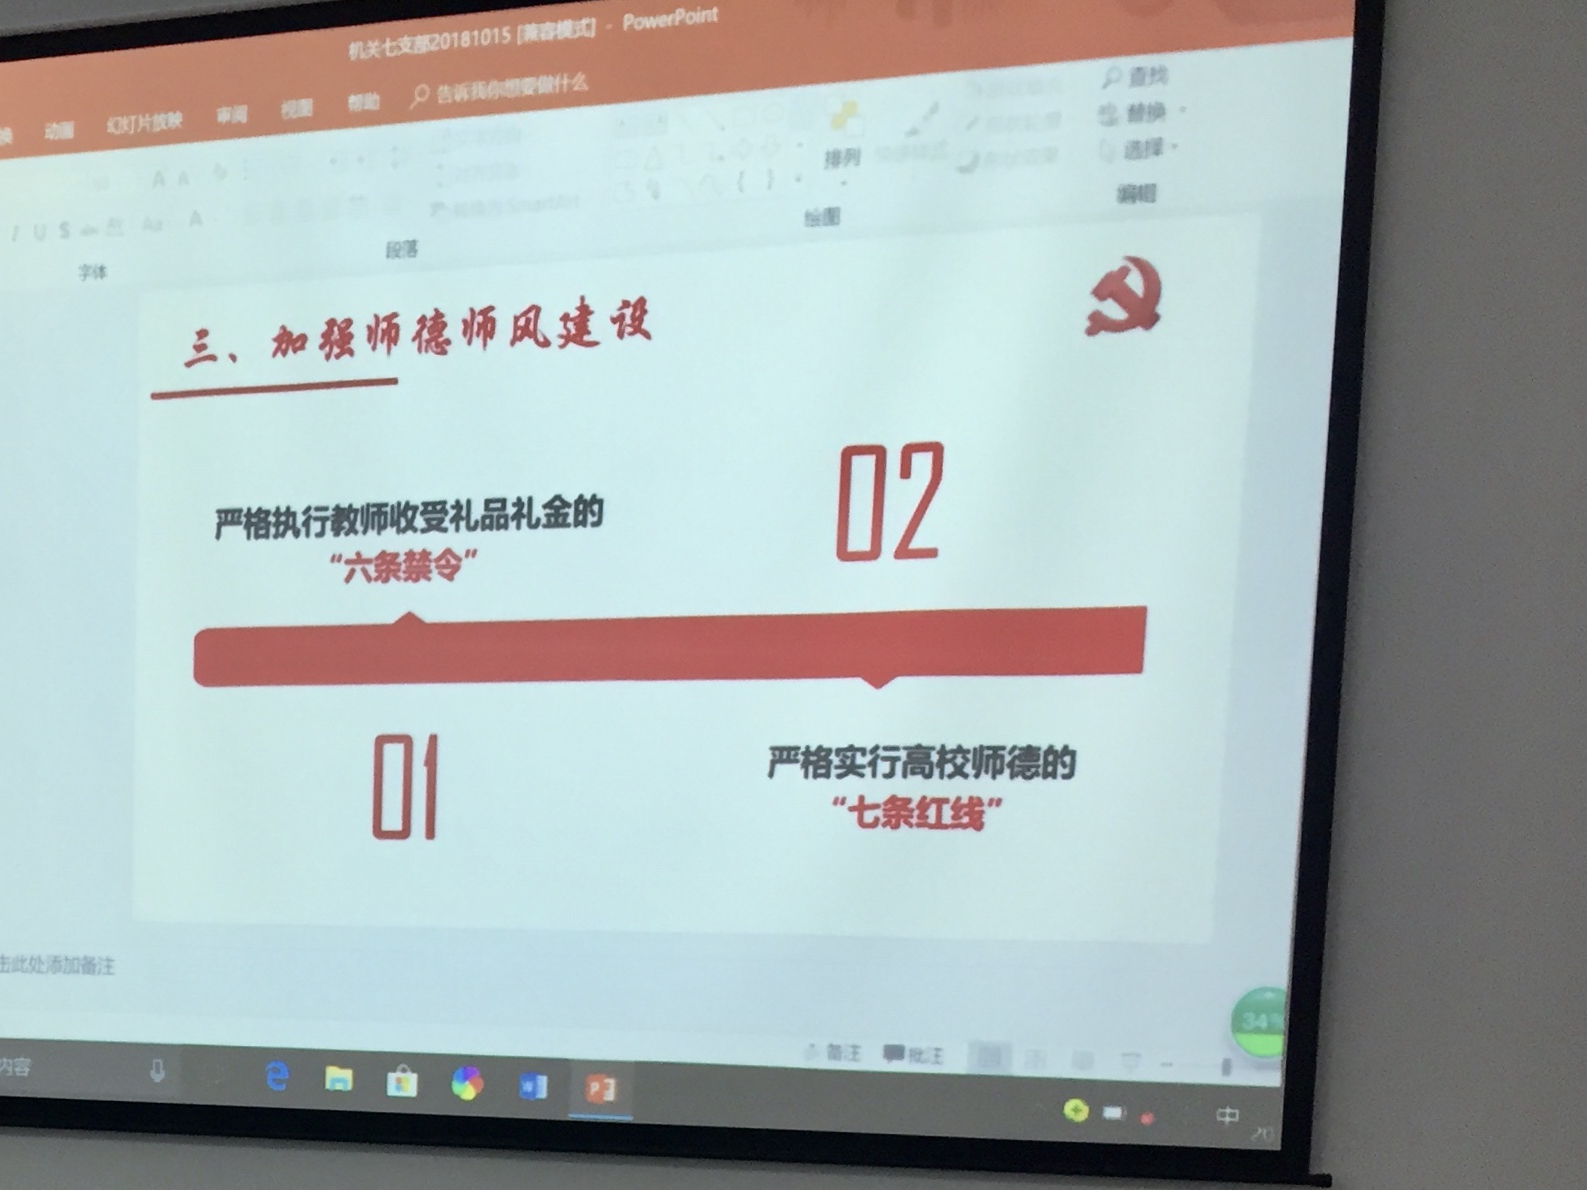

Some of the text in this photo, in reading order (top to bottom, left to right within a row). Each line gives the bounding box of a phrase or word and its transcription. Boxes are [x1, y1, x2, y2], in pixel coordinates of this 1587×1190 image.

[349, 26, 511, 60] 机关七支部20181015
[623, 6, 719, 32] PowerPoint
[183, 294, 653, 369] 三、加强师德师风建设
[214, 493, 605, 541] 严格执行教师收受礼品礼金的
[836, 441, 945, 562] 02
[330, 547, 478, 584] “六条禁令”
[372, 733, 439, 841] 01
[767, 744, 1077, 781] 严格实行高校师德的
[832, 794, 1003, 831] “七条红线”
